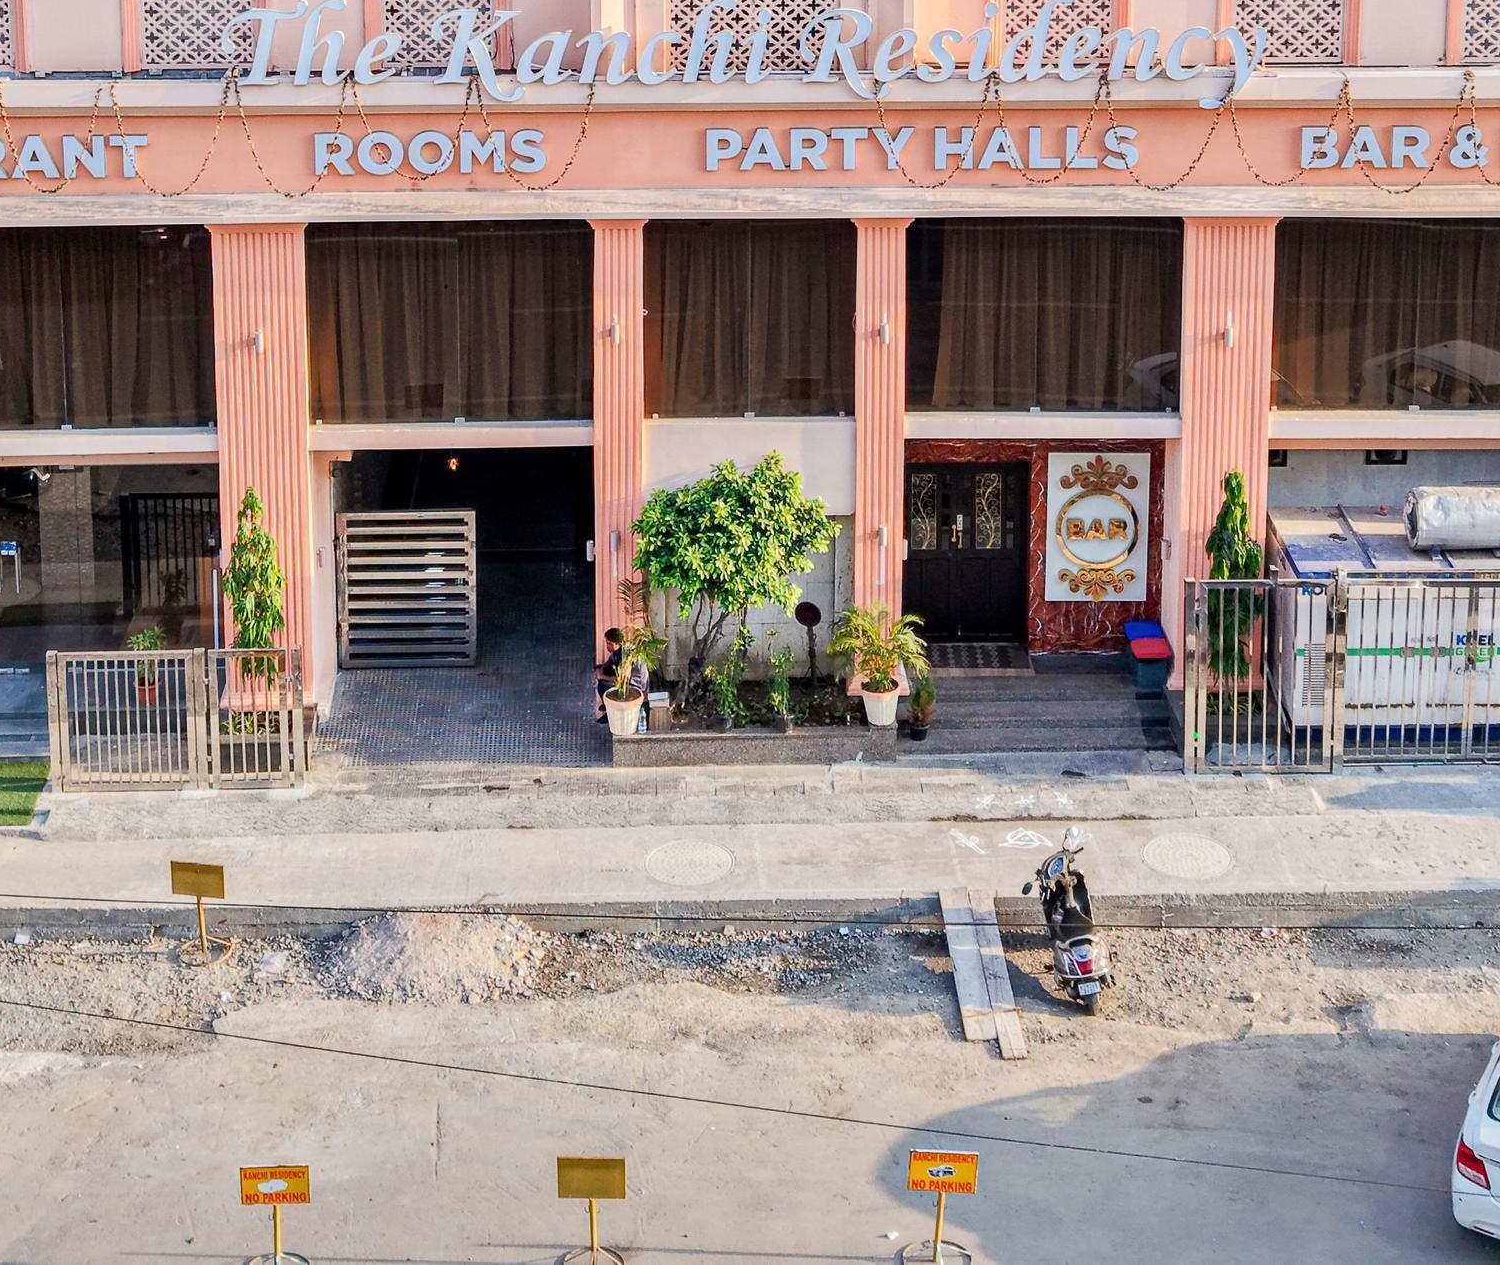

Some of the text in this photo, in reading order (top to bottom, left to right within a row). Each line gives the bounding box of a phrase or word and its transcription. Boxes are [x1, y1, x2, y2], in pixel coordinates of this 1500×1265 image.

[313, 130, 546, 175] ROOMS
[706, 128, 914, 171] PARTY
[934, 127, 1138, 170] HALLS
[1301, 125, 1430, 168] BAR
[1449, 125, 1487, 168] &
[1066, 518, 1129, 541] BAR
[911, 1179, 972, 1192] NO PARKING
[245, 1192, 307, 1204] NO PARKING
